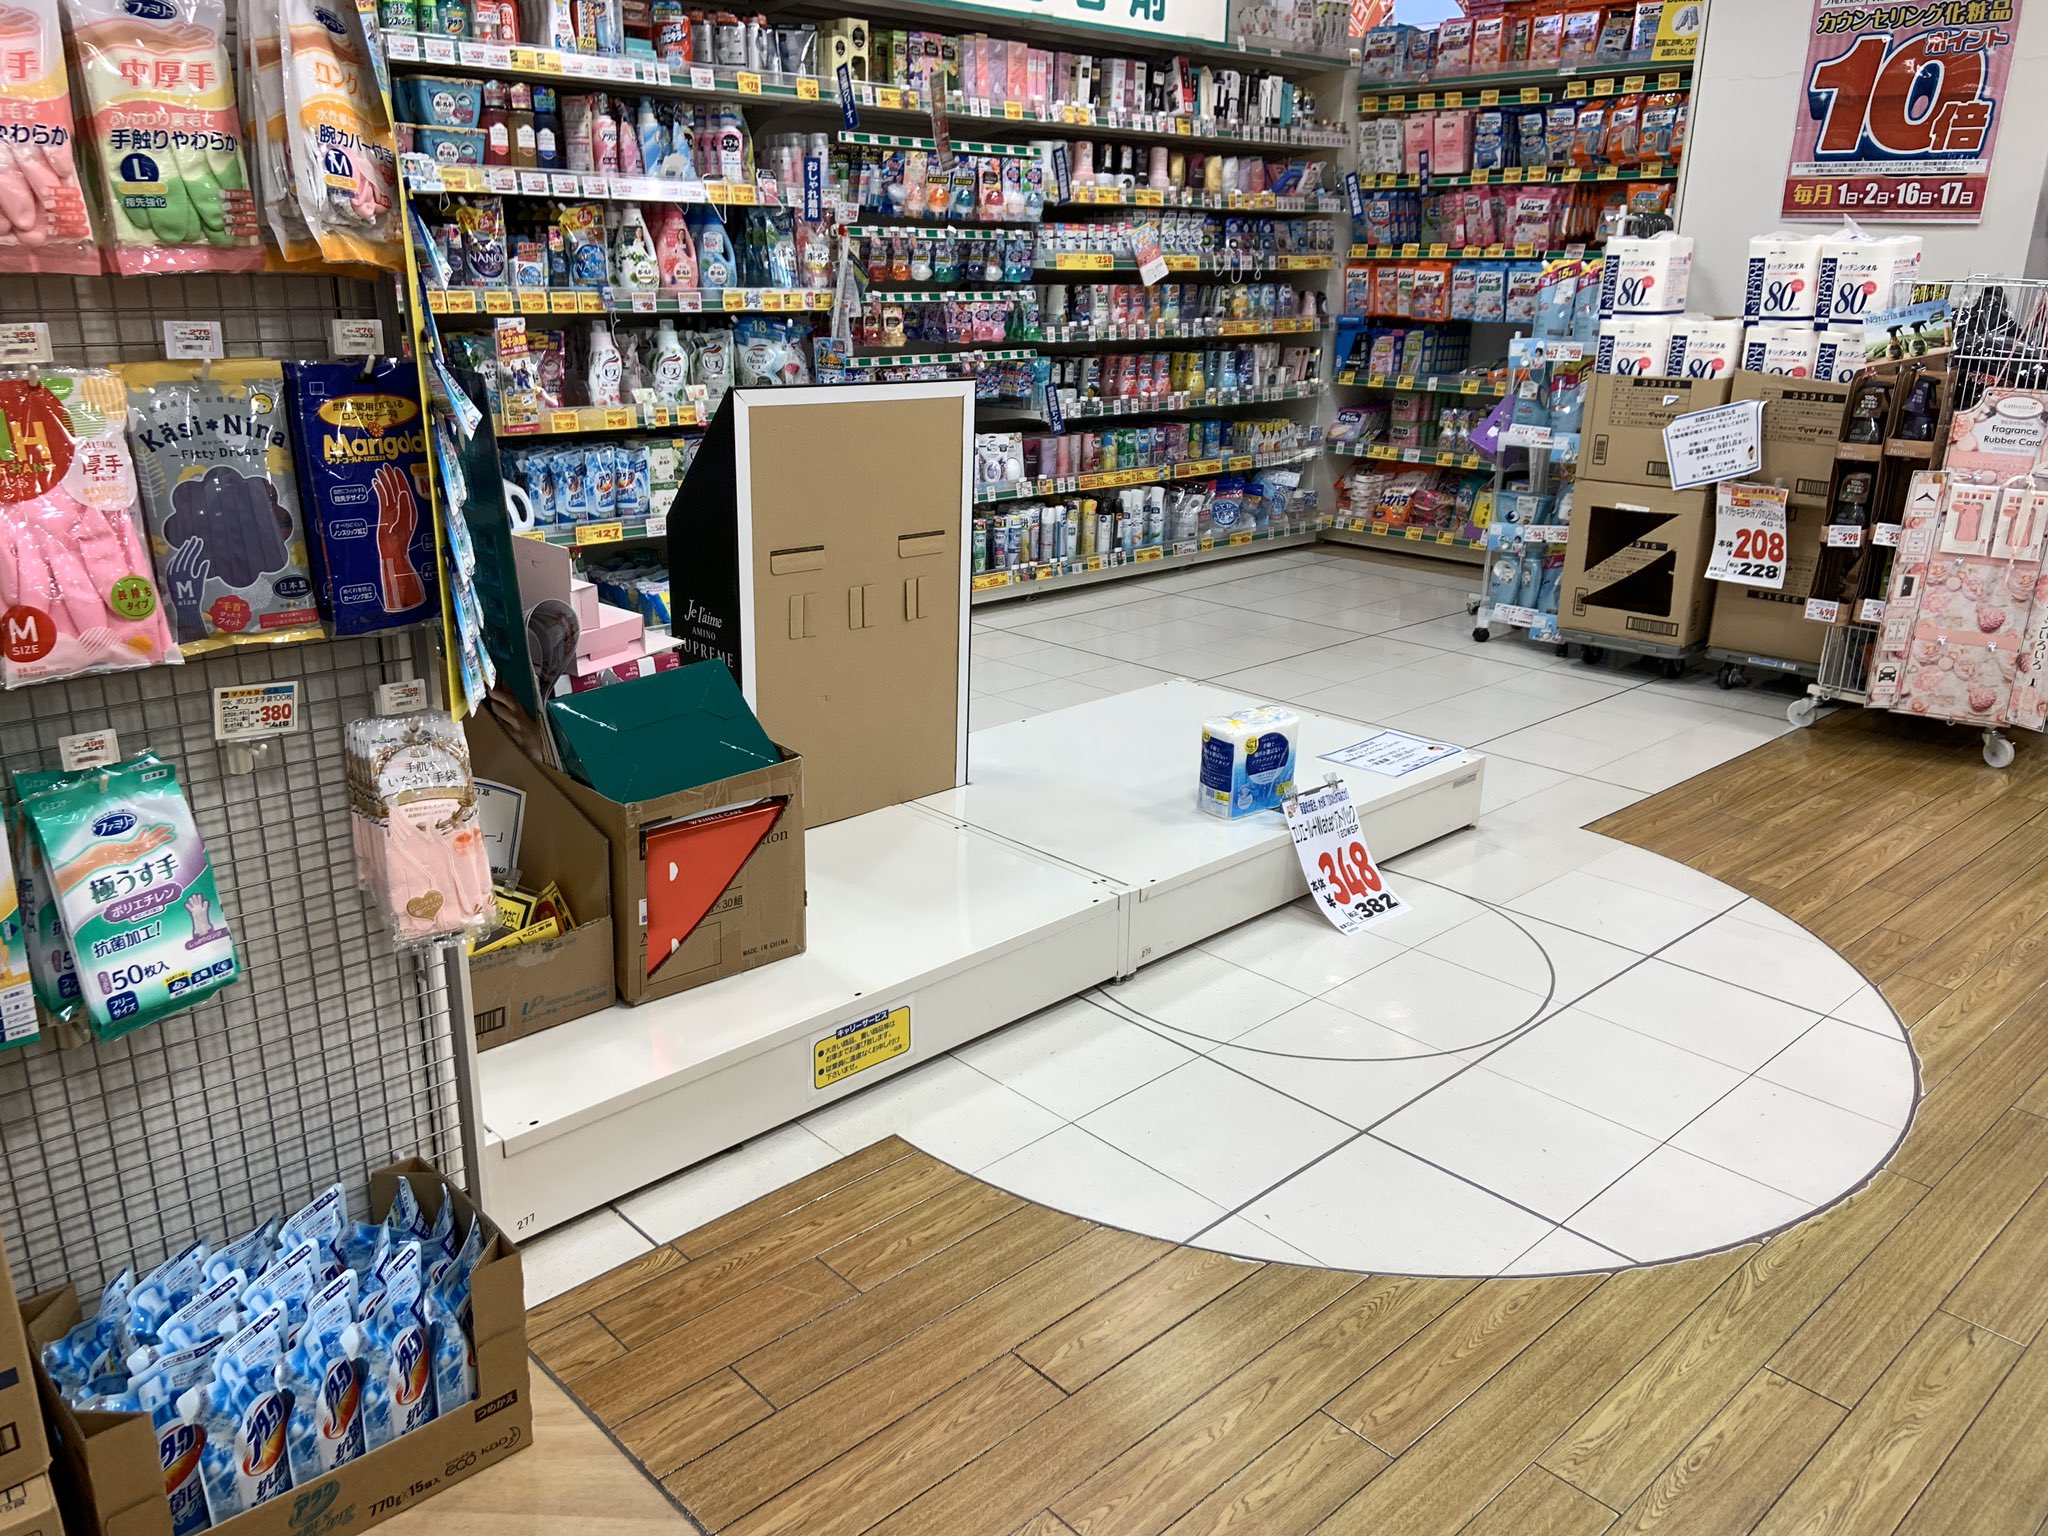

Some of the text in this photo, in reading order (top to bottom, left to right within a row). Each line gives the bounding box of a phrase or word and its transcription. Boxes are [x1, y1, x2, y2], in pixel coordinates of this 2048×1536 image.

[1817, 0, 2013, 33] カウンセリング化粧品
[1925, 28, 2008, 54] ポイント
[120, 57, 216, 90] 中厚手
[1810, 32, 1988, 158] 10
[1929, 101, 1995, 153] 倍
[111, 128, 238, 152] 手触りやわらか
[319, 123, 393, 164] 腕カバー付き
[133, 158, 150, 180] L
[329, 152, 351, 177] M
[806, 161, 819, 218] おしゃれ着用
[1793, 184, 1833, 205] 毎月
[1617, 276, 1647, 307] 80
[1763, 280, 1797, 312] 80
[1834, 282, 1868, 315] 80
[1983, 435, 2043, 447] Rubber Card
[1992, 424, 2039, 435] Fragrance
[323, 431, 427, 459] Marigold
[83, 454, 124, 476] 厚手
[1718, 539, 1734, 548] 本体
[1732, 528, 1784, 563] 208
[1738, 562, 1779, 579] 228
[117, 586, 152, 603] 長持ち
[177, 580, 195, 599] M
[126, 599, 151, 611] タイプ
[684, 599, 698, 621] Je
[8, 615, 38, 645] M
[692, 626, 717, 641] AMINO
[12, 645, 40, 656] SIZE
[676, 635, 734, 669] SUPREME
[260, 703, 292, 723] 380
[97, 814, 137, 832] ファミリー
[688, 809, 744, 826] WRINKLE CARE
[89, 853, 180, 901] 極うす手
[1310, 877, 1327, 893] 本体
[1317, 841, 1382, 905] 348
[111, 888, 175, 920] ポリエチレン
[1355, 893, 1400, 919] 382
[93, 926, 161, 960] 抗菌加工!
[742, 946, 758, 957] MADE
[769, 939, 789, 949] CHINA
[112, 958, 172, 991] 50枚入
[110, 997, 134, 1010] フリー
[111, 1006, 137, 1020] サイズ
[837, 1011, 888, 1037] キャリーサービス
[516, 1212, 536, 1231] 277
[477, 1393, 516, 1420] つめかえ
[160, 1424, 195, 1470] タック
